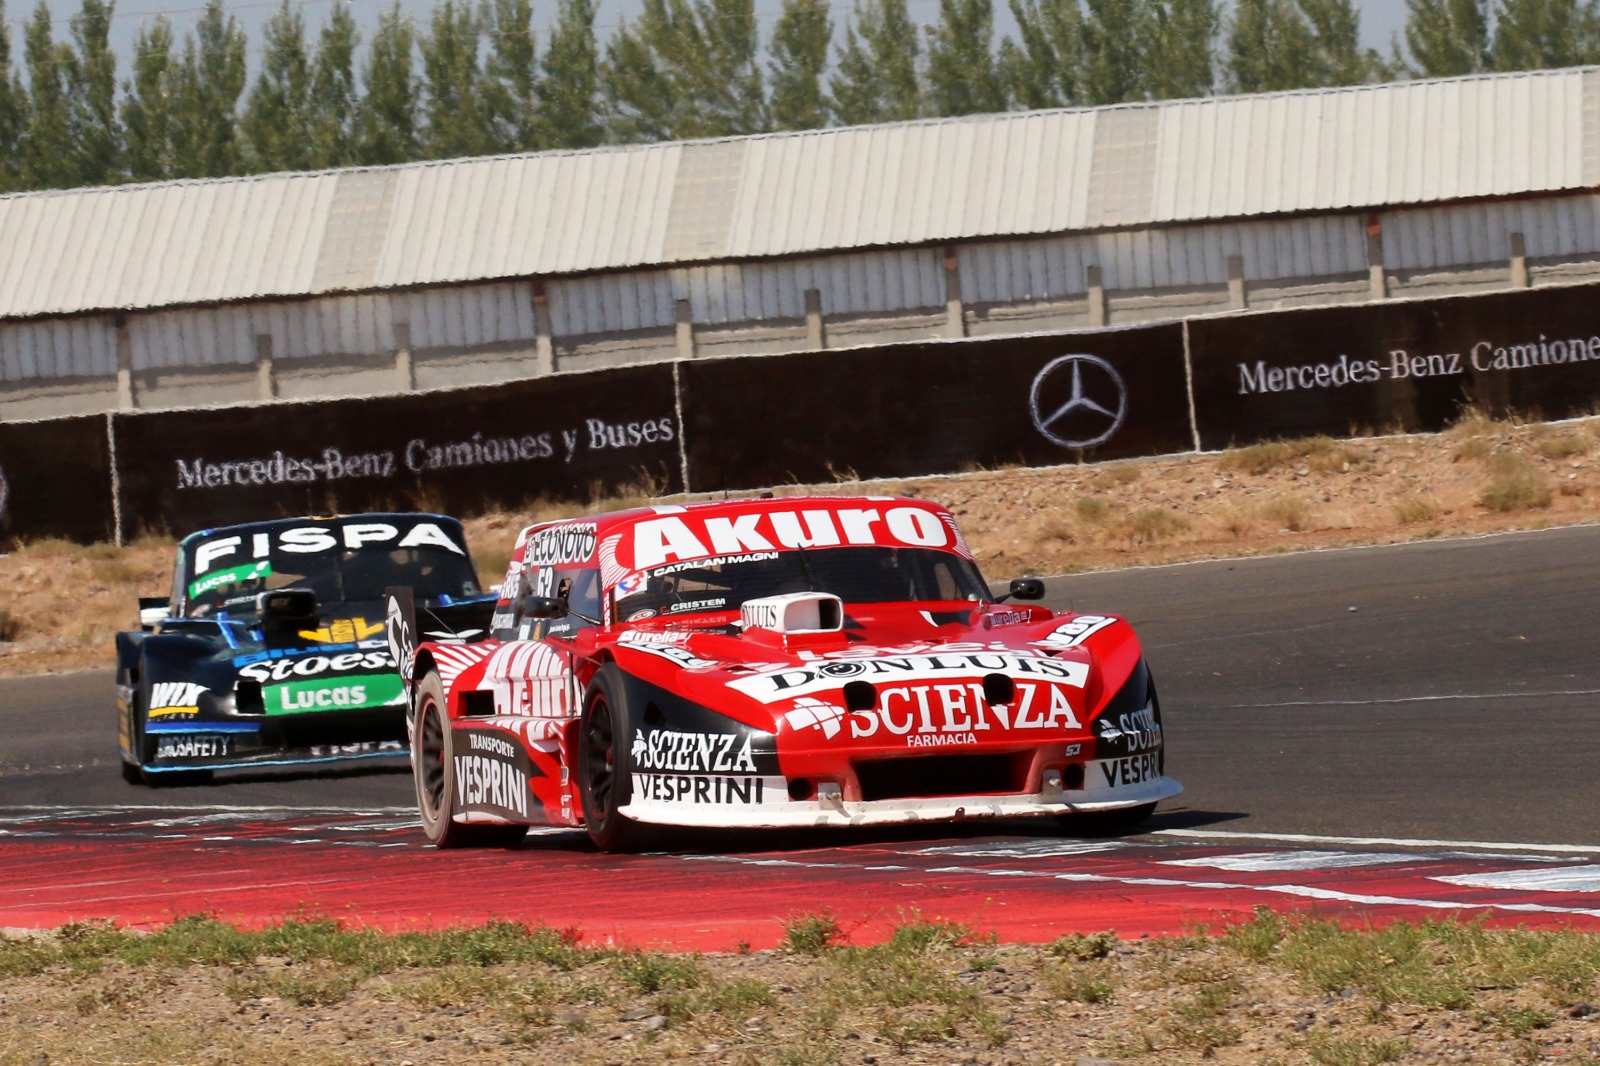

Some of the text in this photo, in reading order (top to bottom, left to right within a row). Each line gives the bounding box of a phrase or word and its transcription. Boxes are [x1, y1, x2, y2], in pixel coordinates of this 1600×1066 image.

[1237, 350, 1463, 395] Mercedes-Benz
[175, 417, 675, 489] Mercedes-Benz Camiones y Buses
[195, 523, 466, 575] FISPA
[654, 557, 727, 578] CATALAN
[727, 551, 779, 565] MAGNI
[195, 572, 238, 595] Lucas
[670, 598, 726, 612] CRISTEM
[150, 682, 211, 709] WIX
[281, 685, 367, 710] Lucas
[850, 683, 1083, 739] SCIENZA
[469, 733, 515, 758] TRANSPORTE
[644, 729, 758, 773] SCIENZA
[906, 732, 978, 748] FARMACIA
[1065, 743, 1082, 757] 53
[454, 755, 528, 819] VESPRINI
[639, 774, 764, 805] VESPRINI
